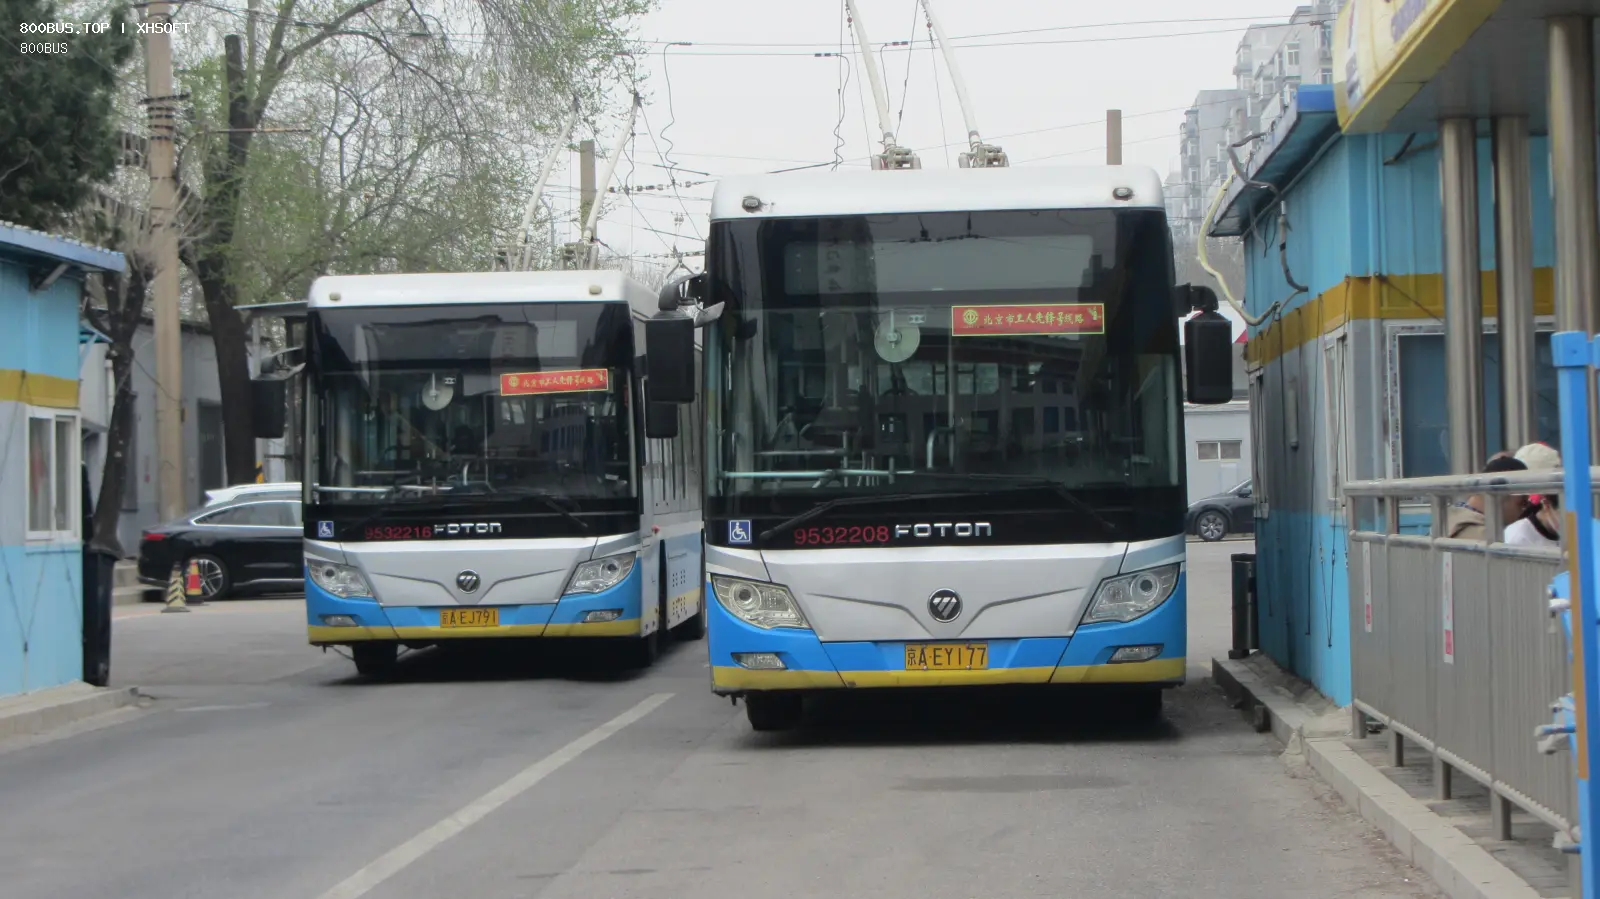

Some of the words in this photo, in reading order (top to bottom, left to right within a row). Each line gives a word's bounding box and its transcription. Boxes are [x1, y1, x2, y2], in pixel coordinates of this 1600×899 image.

[983, 311, 1085, 326] 北京市工人先锋号线路
[365, 525, 432, 539] 9532216
[434, 522, 502, 534] FOTON
[794, 525, 890, 545] 9532208
[895, 522, 992, 538] FOTON
